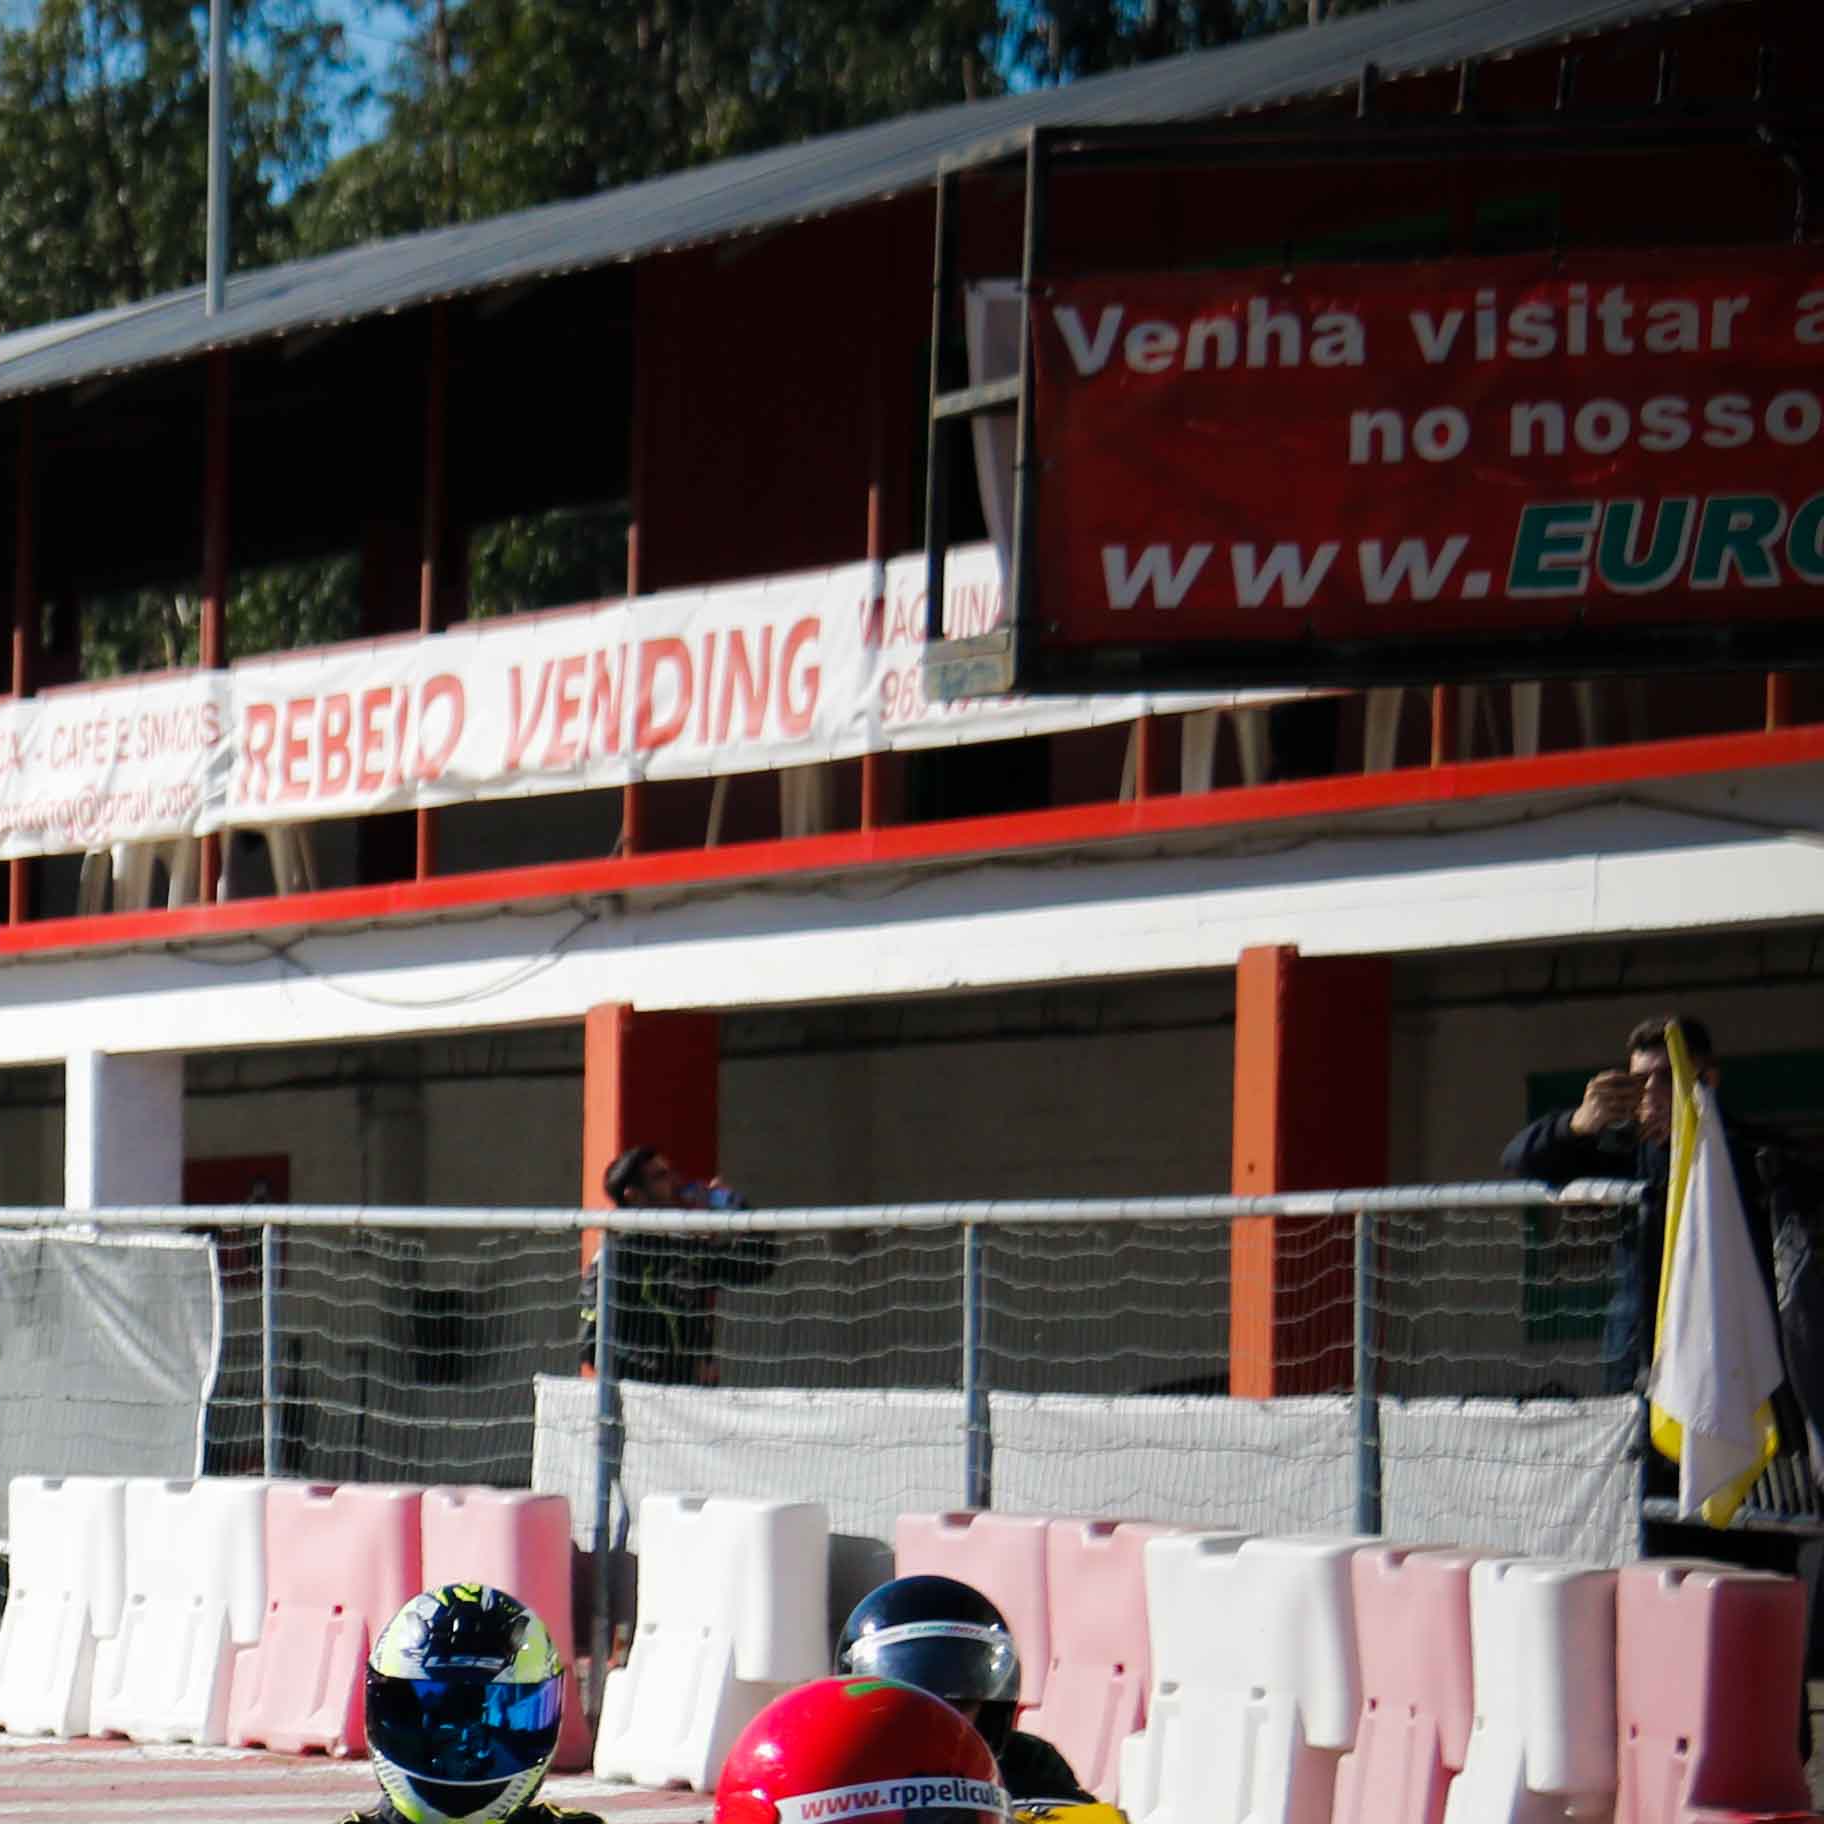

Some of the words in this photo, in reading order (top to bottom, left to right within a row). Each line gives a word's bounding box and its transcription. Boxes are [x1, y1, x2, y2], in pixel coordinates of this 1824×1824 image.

[1053, 297, 1366, 378] Venha
[1410, 284, 1751, 364] visitar
[1349, 402, 1470, 464] no
[1509, 389, 1824, 457] nosso
[502, 616, 821, 771] VENDING
